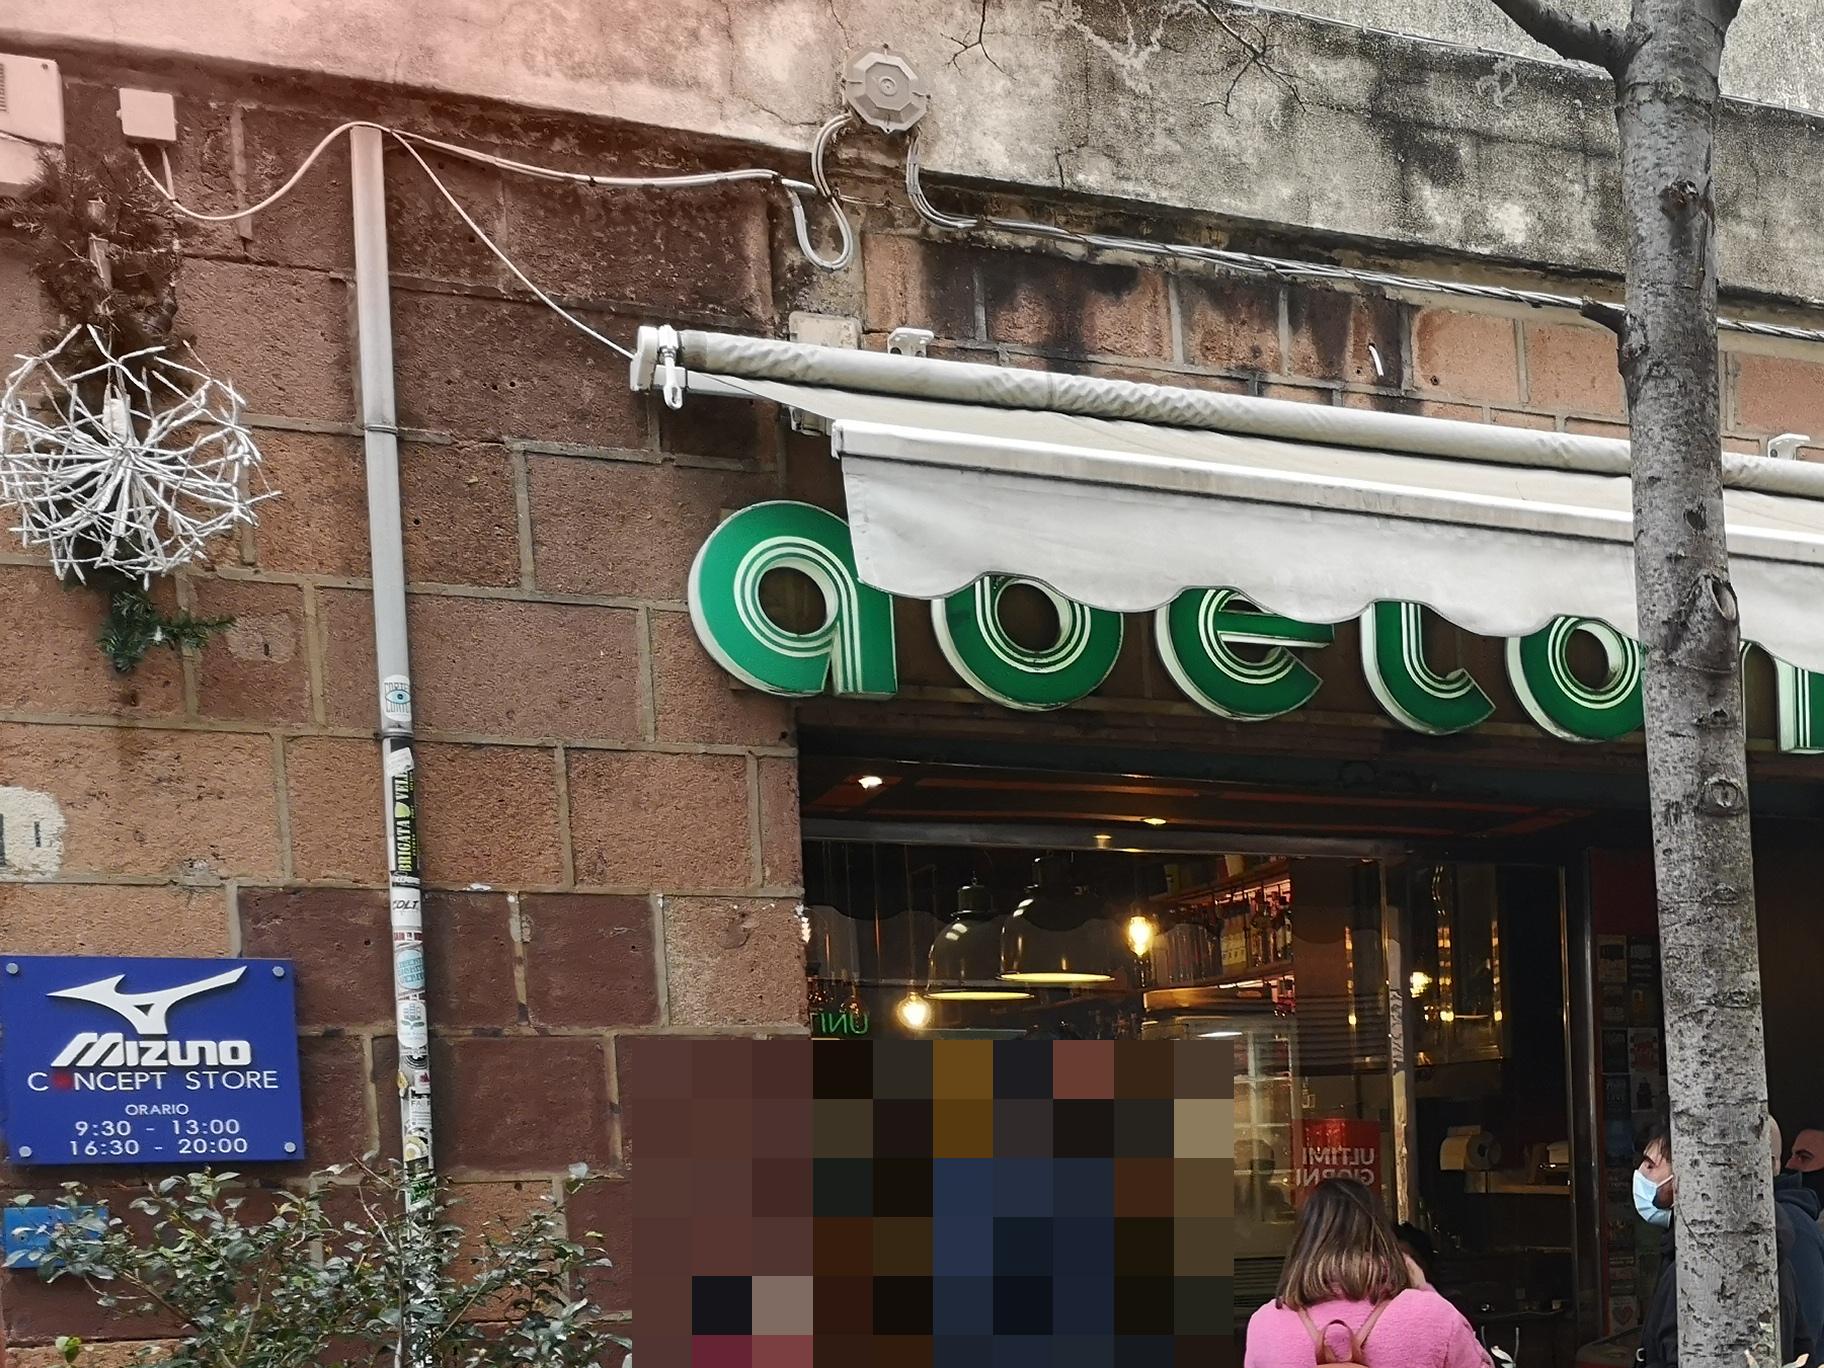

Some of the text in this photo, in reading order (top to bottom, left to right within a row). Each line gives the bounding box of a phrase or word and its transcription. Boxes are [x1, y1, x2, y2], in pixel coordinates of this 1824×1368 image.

[396, 820, 412, 872] BRIGATA
[185, 1070, 278, 1089] STORE
[125, 1103, 189, 1116] ORARIO
[74, 1120, 131, 1136] 9:30
[172, 1119, 240, 1135] 13:00
[70, 1140, 139, 1156] 16:30
[178, 1138, 247, 1154] 20:00
